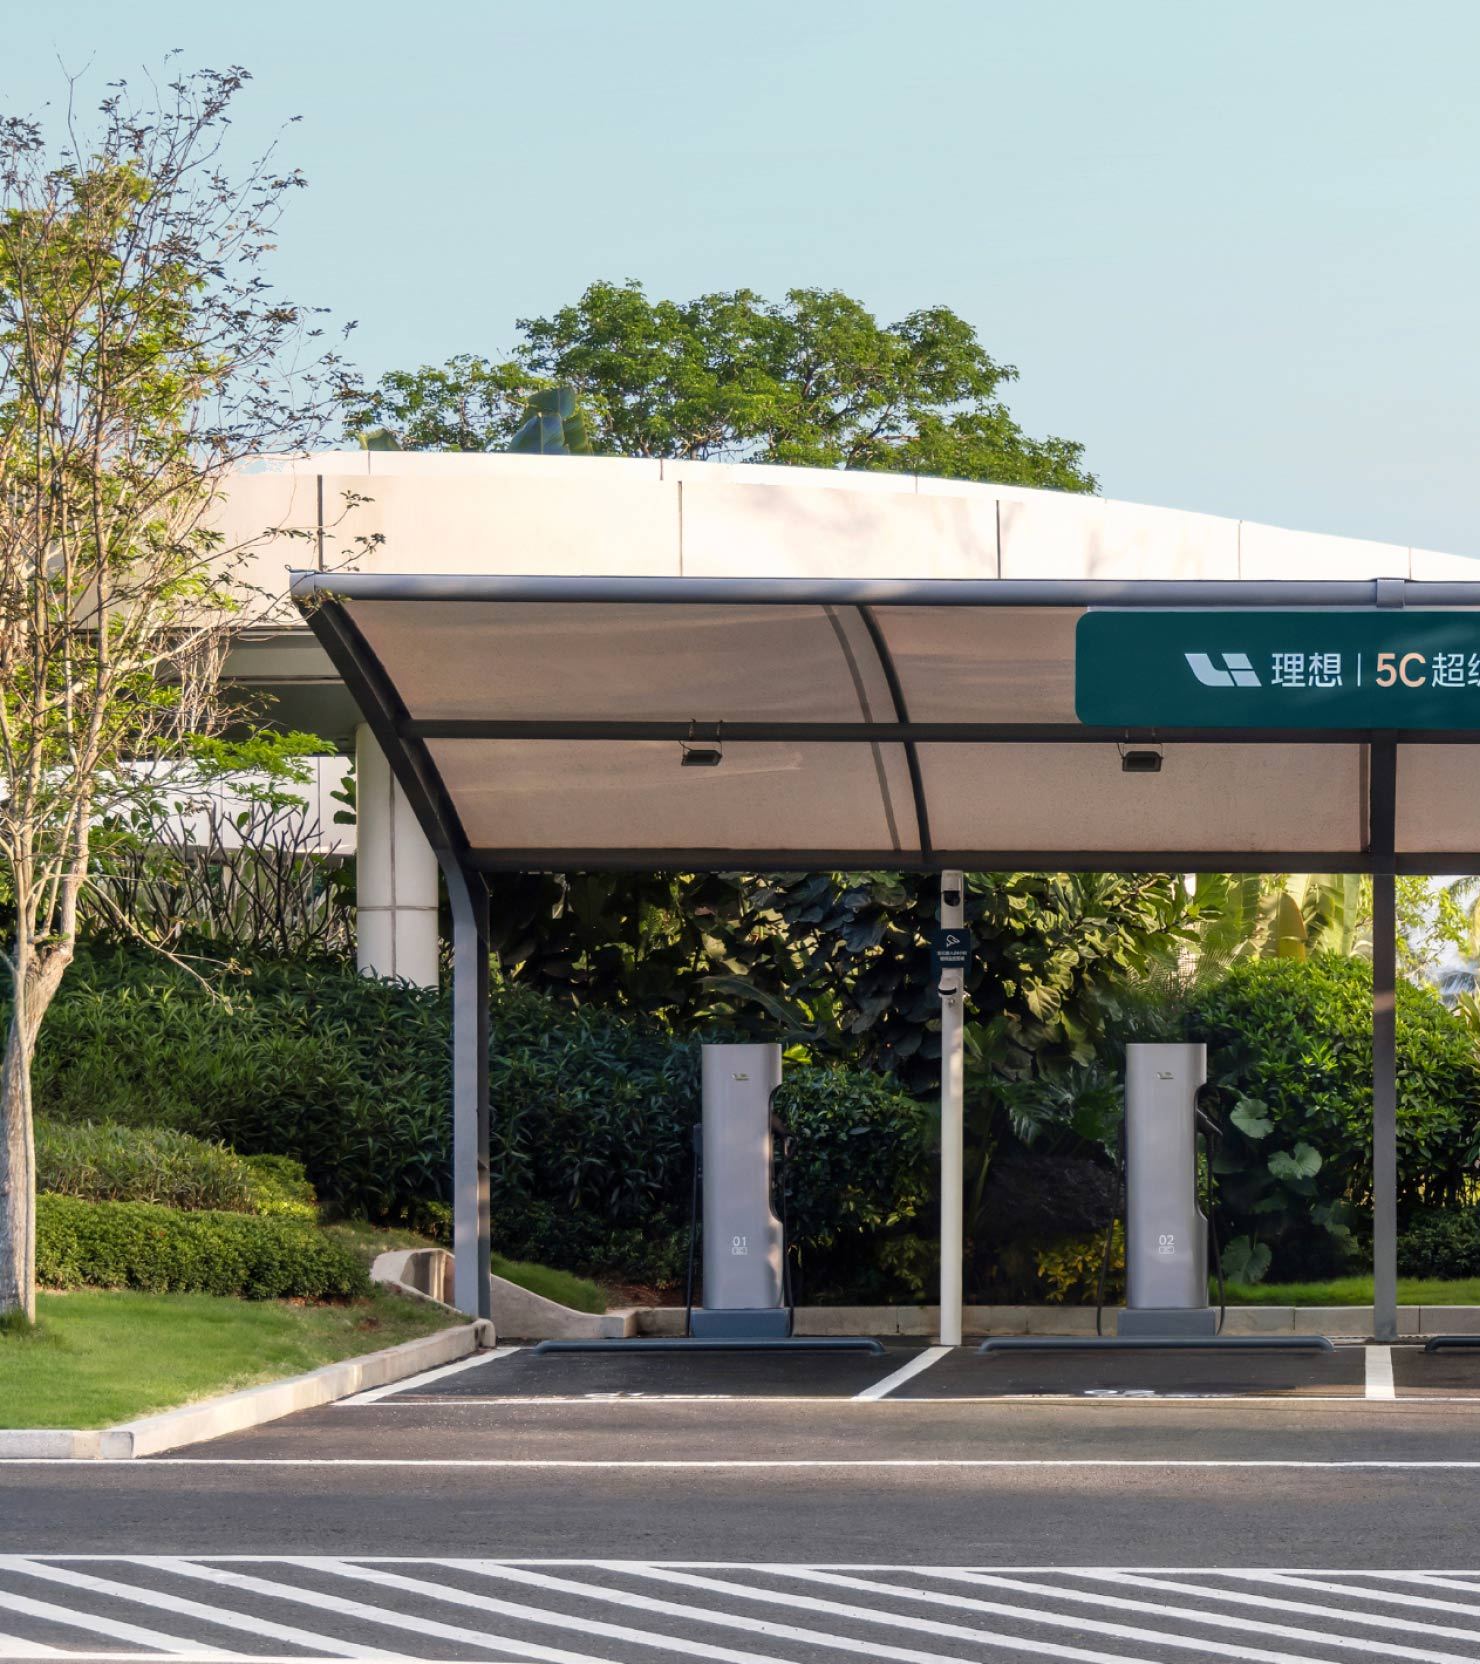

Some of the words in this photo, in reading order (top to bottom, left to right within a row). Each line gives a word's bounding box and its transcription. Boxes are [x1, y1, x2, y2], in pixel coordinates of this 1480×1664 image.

[1271, 652, 1343, 688] 理想
[732, 1236, 746, 1247] 01
[1158, 1234, 1175, 1246] 02
